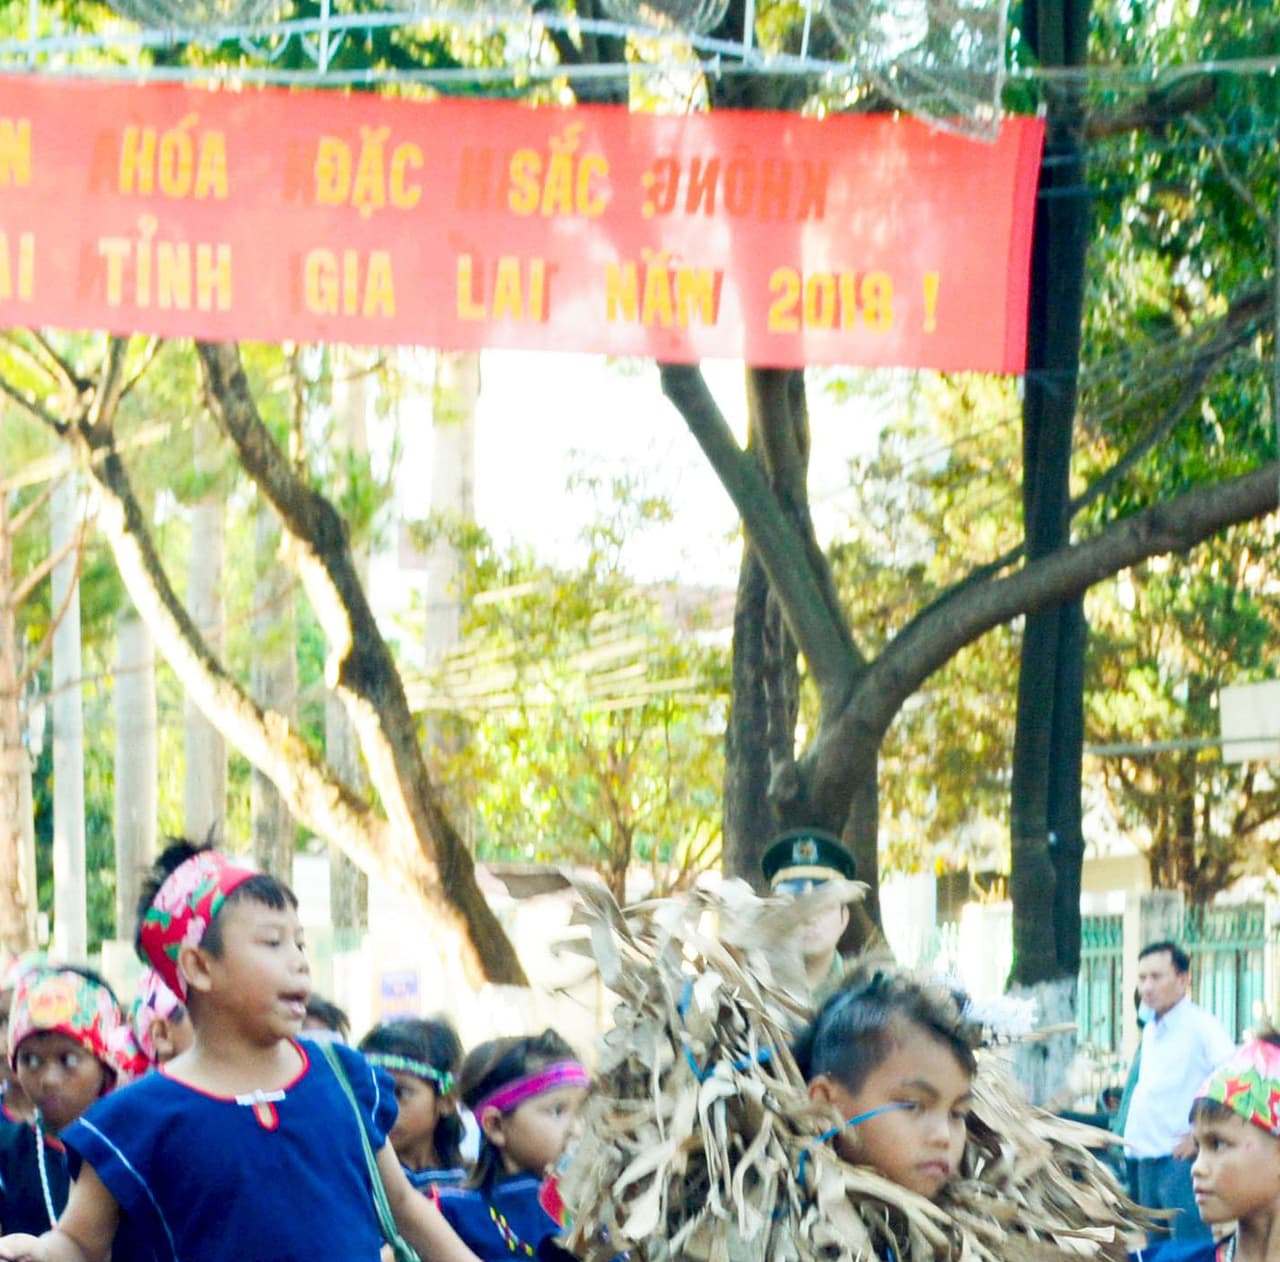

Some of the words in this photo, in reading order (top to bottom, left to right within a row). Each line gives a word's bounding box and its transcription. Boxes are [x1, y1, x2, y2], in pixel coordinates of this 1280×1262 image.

[121, 114, 229, 198] HÓA
[314, 126, 423, 217] ĐẶC
[509, 121, 609, 217] SẮC
[99, 214, 232, 310] TỈNH
[305, 247, 396, 318] GIA
[457, 254, 544, 322] LAI
[605, 247, 718, 327] NĂM
[768, 268, 894, 333] 2018
